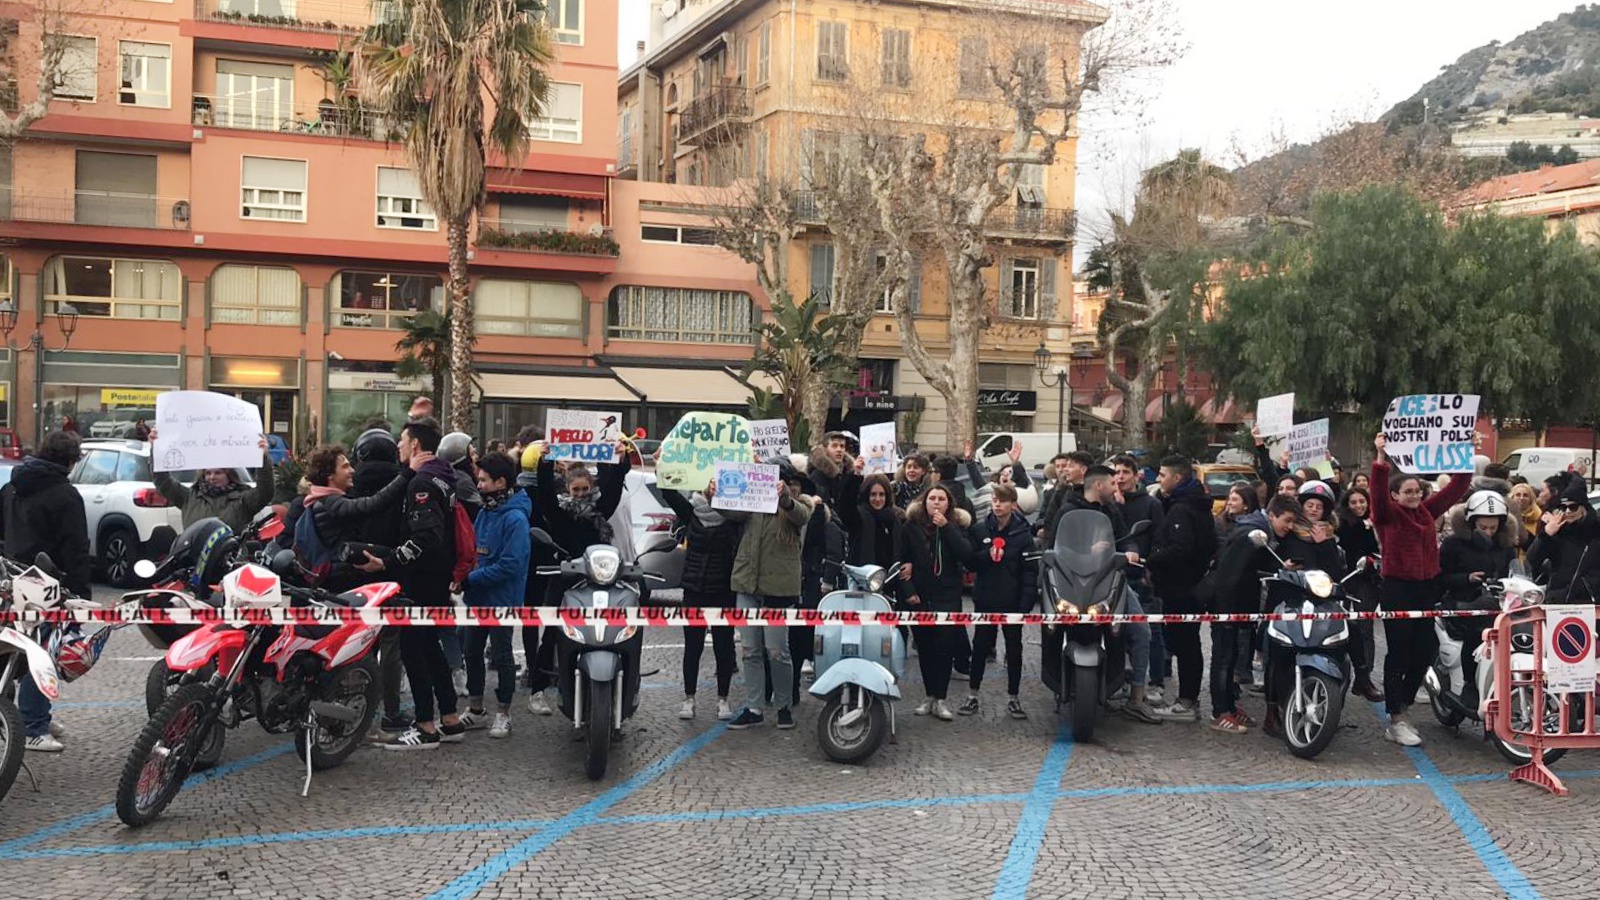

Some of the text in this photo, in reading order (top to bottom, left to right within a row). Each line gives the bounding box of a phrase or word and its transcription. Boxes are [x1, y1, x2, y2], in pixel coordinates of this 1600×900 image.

[1440, 395, 1463, 409] LO
[1385, 416, 1475, 429] VOGLIAMO SUI
[1386, 430, 1471, 442] NOSTRI POLS
[1403, 454, 1414, 467] IN
[1414, 443, 1474, 471] CLASSE
[43, 585, 58, 602] 21
[190, 607, 274, 621] POLIZIA
[283, 607, 362, 621] LOCALE
[379, 607, 457, 620] POLIZIA
[466, 607, 540, 620] LOCALE
[556, 607, 628, 620] POLIZIA
[636, 607, 705, 620] LOCALE
[720, 608, 788, 620] POLIZIA
[795, 609, 860, 621] LOCALE
